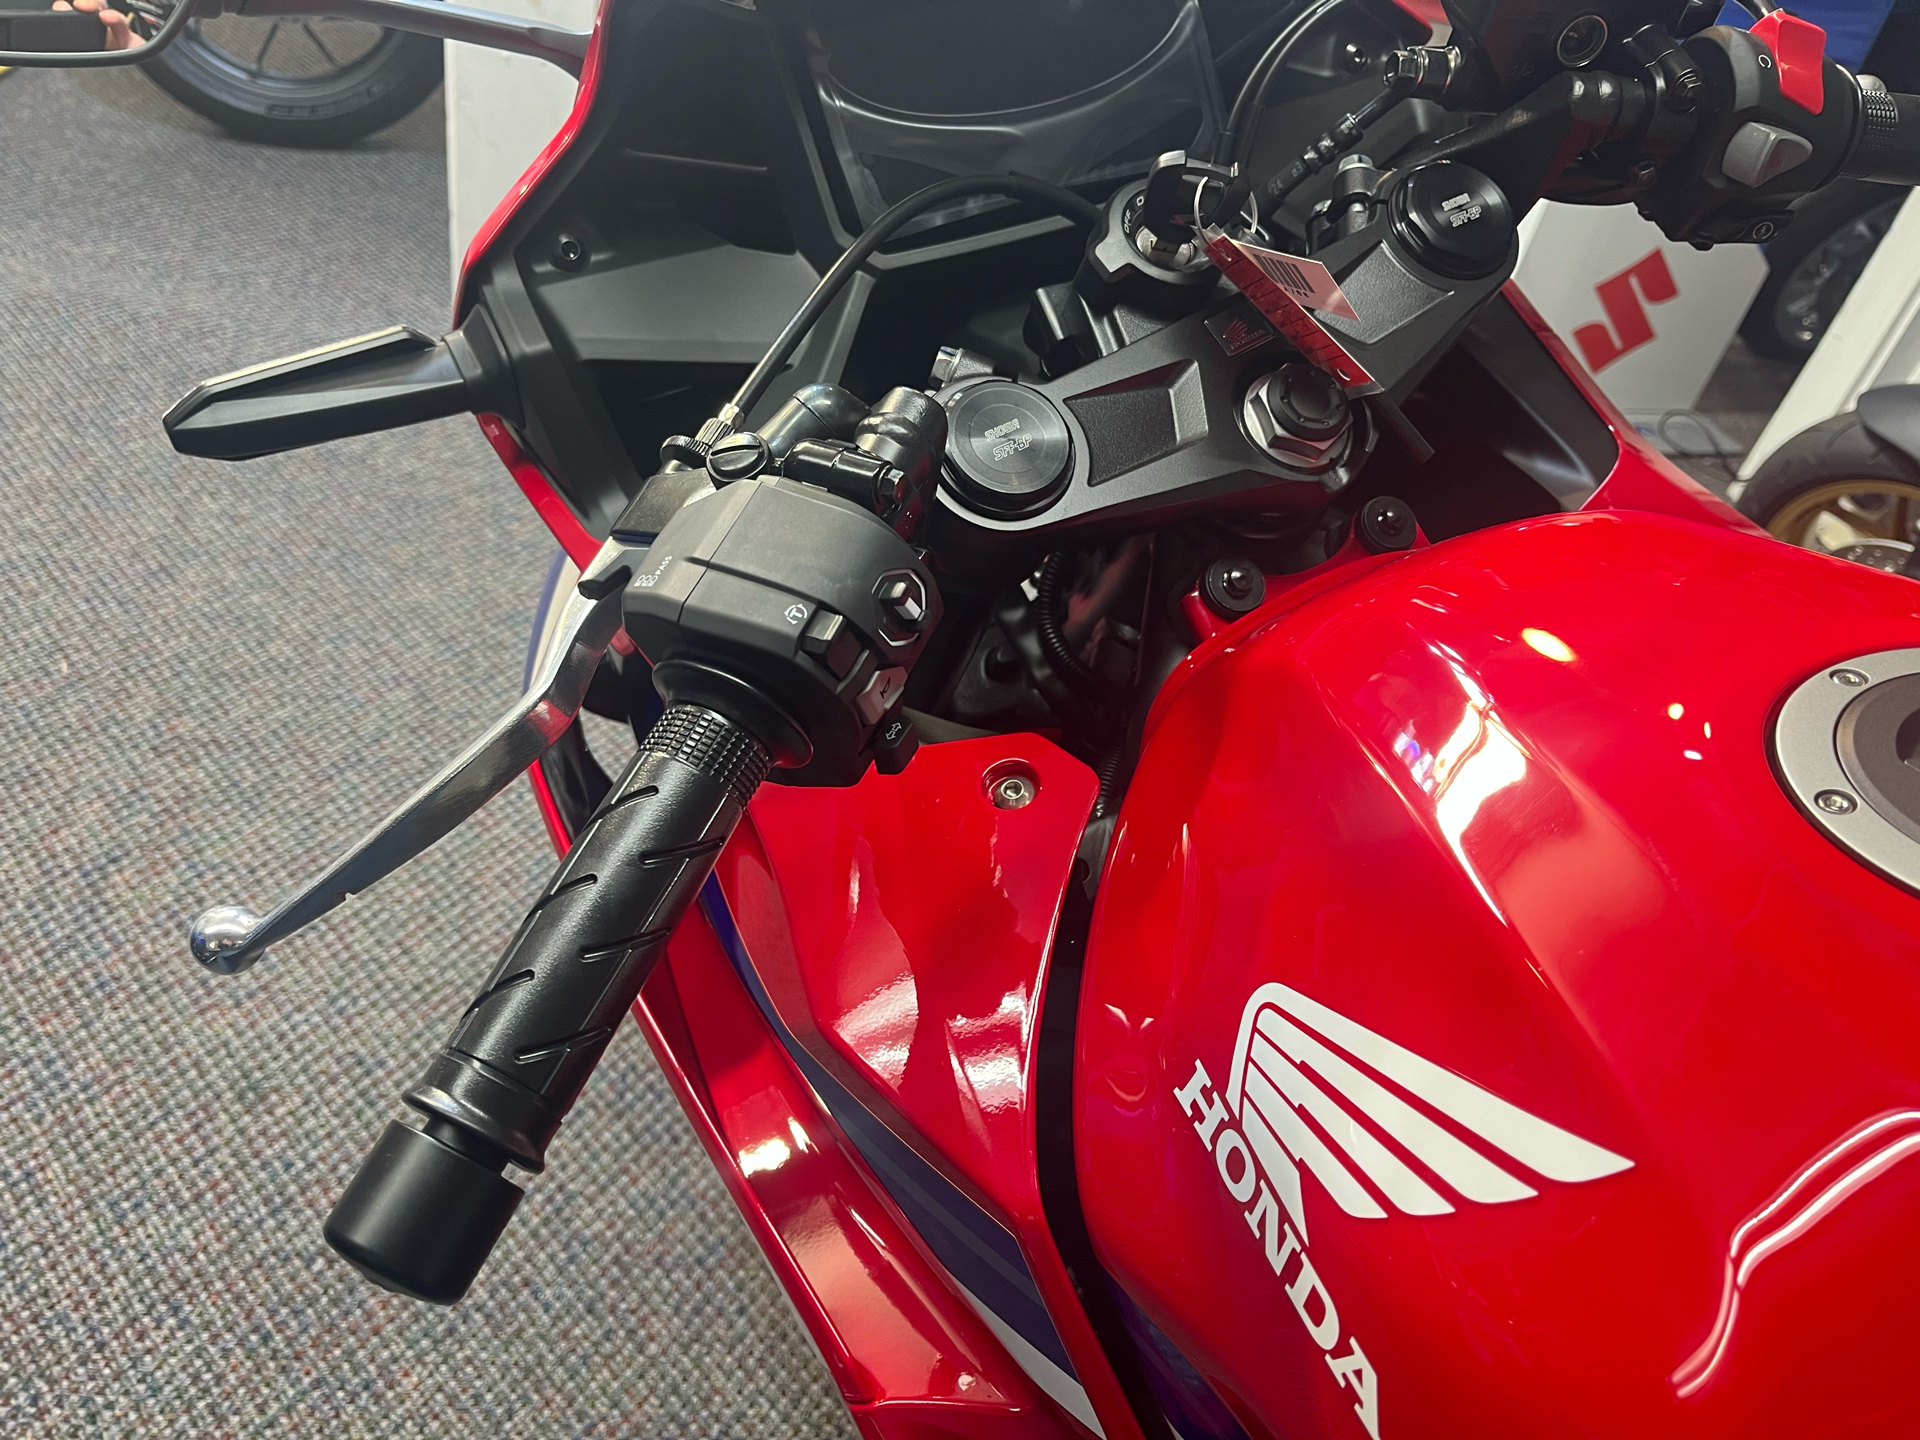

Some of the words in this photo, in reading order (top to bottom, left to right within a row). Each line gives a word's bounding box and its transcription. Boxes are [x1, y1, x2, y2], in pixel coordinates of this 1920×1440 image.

[1123, 209, 1132, 234] OFF
[984, 418, 1021, 441] SHOWA
[992, 433, 1033, 462] SFF-BP
[654, 555, 673, 575] PASS
[1173, 1058, 1381, 1440] HONDA
